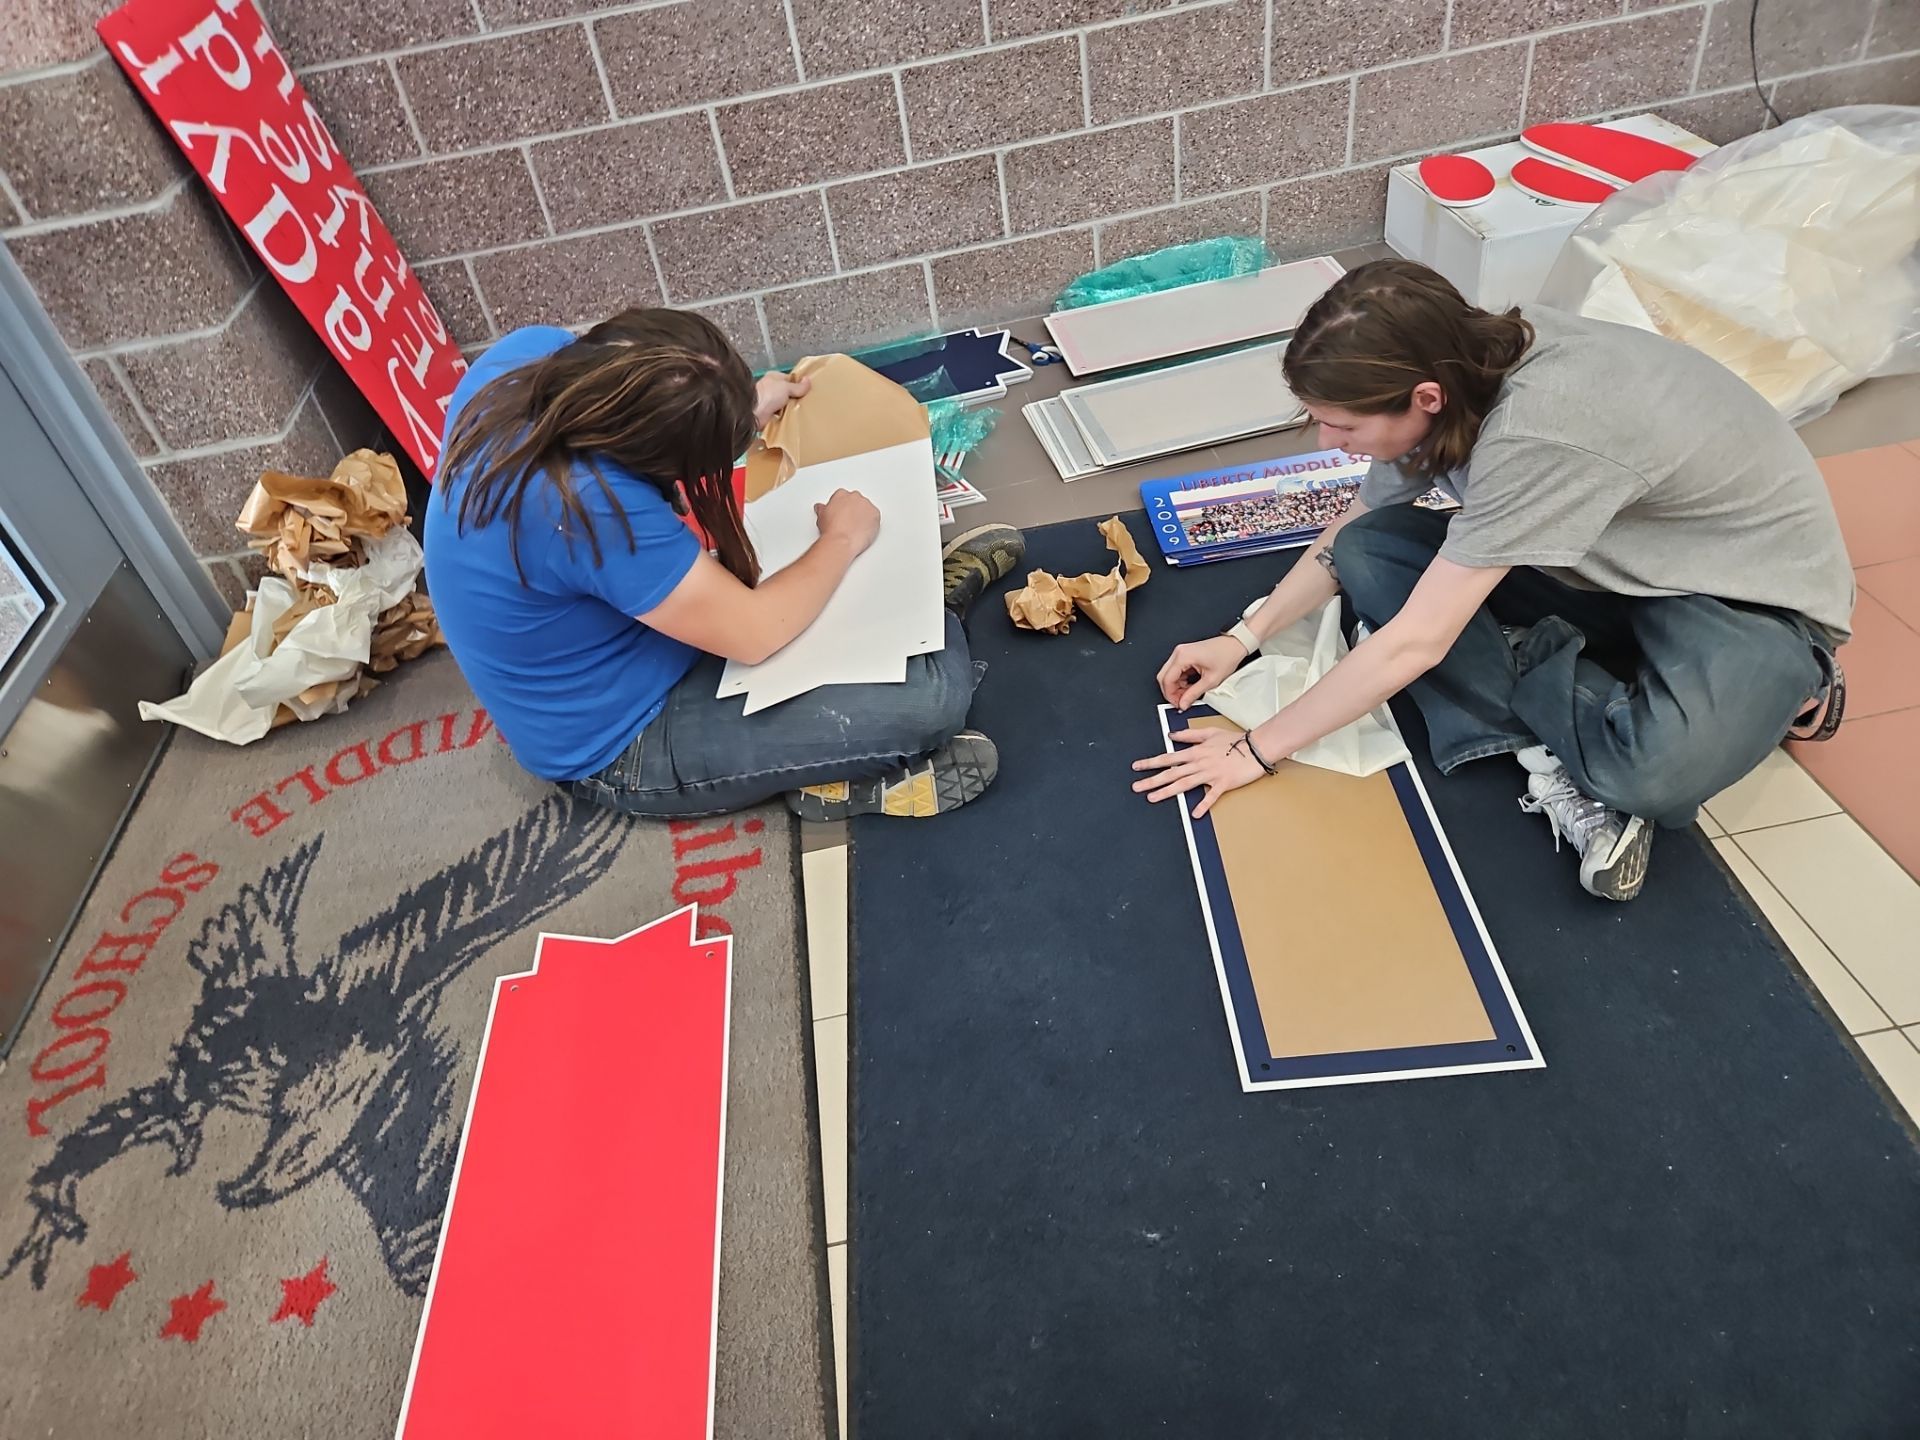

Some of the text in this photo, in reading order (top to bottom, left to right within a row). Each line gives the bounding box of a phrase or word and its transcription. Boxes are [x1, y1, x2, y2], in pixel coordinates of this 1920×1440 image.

[1180, 470, 1256, 492] LIBERTY
[1263, 456, 1342, 480] MIDDLE
[1825, 688, 1842, 728] Supreme
[27, 853, 219, 1138] SCHOOL
